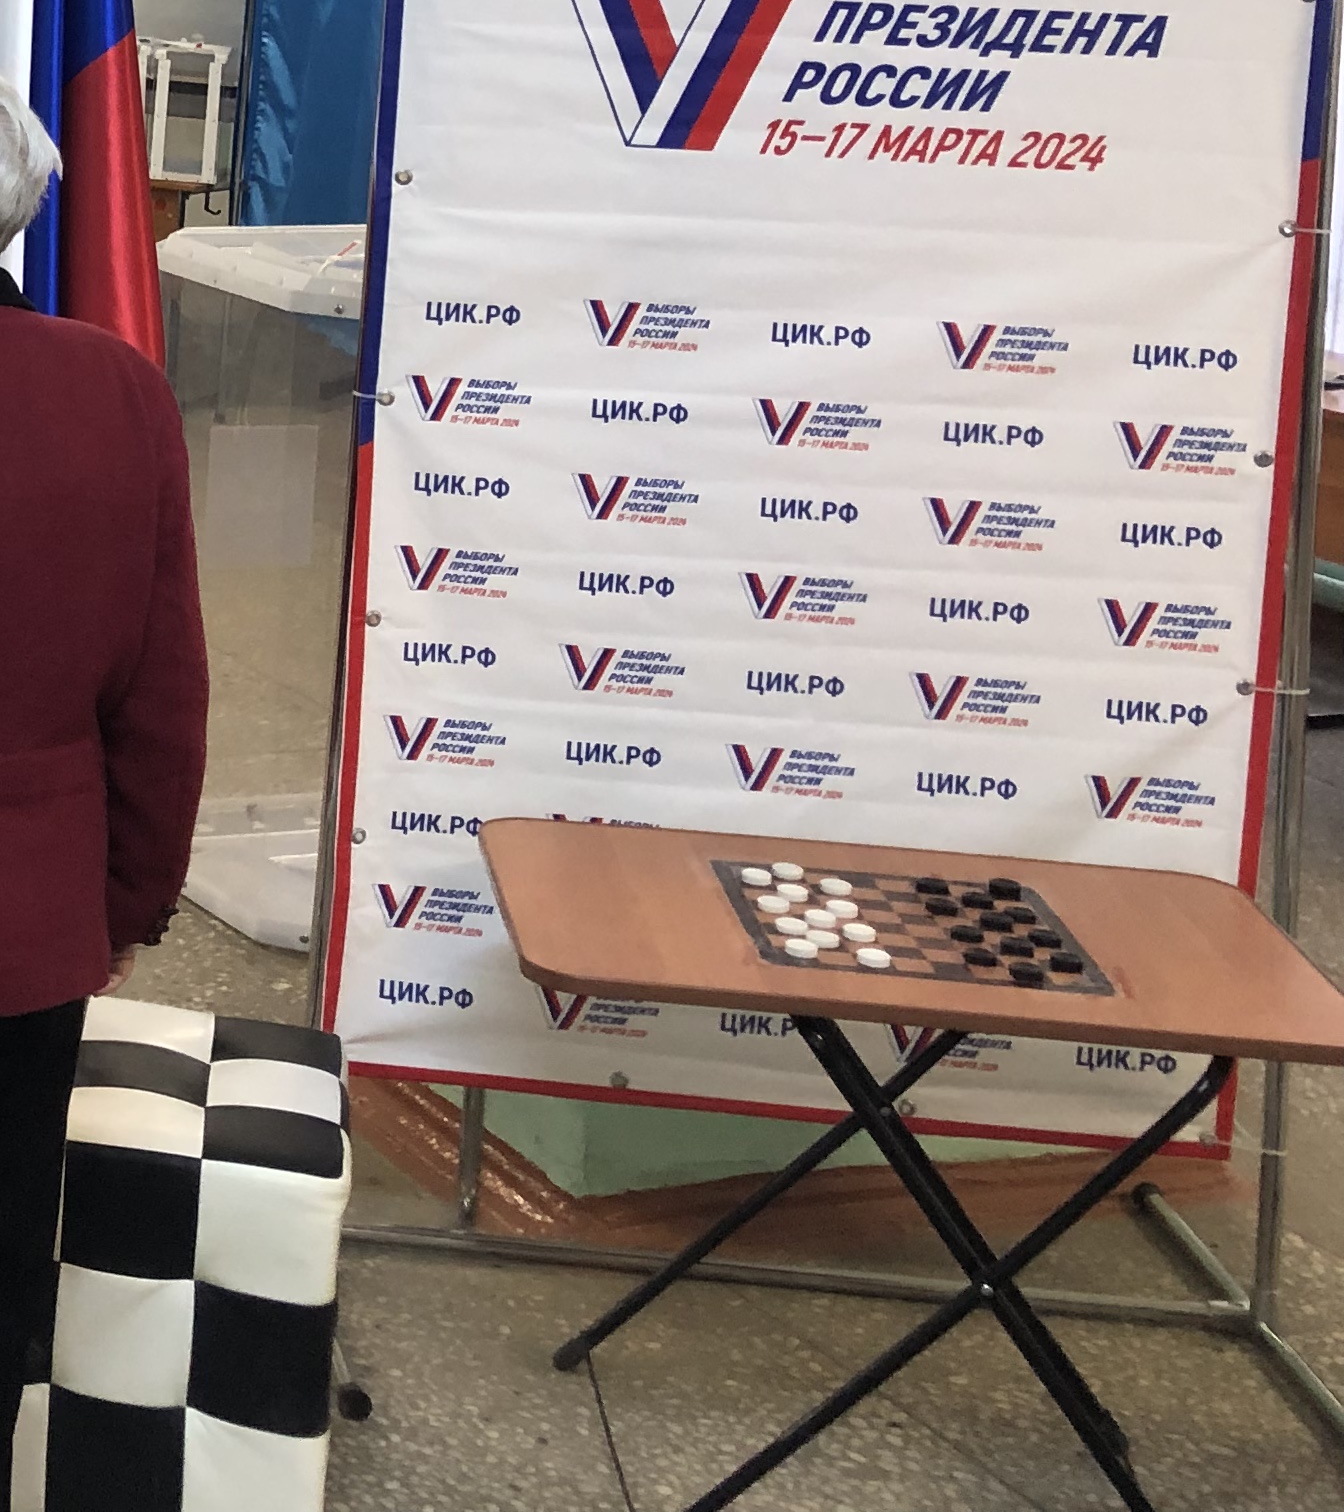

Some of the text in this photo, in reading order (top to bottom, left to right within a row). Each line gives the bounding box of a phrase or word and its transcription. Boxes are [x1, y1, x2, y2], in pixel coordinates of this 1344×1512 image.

[814, 1, 1169, 59] ПРЕЗИДЕНТА
[782, 61, 1010, 112] РОССИИ
[868, 124, 1003, 168] МАРТА
[1007, 131, 1107, 172] 2024
[426, 301, 520, 326] ЦИК.РФ
[646, 304, 696, 315] ВЫБОРЫ
[640, 316, 710, 329] ПРЕЗИДЕНТА
[633, 328, 678, 339] РОССИИ
[772, 322, 871, 348] ЦИК.РФ
[1133, 344, 1237, 371] ЦИК.РФ
[467, 379, 517, 391] ВЫБОРЫ
[462, 392, 531, 404] ПРЕЗИДЕНТА
[455, 403, 500, 414] РОССИИ
[592, 399, 688, 424] ЦИК.РФ
[816, 403, 868, 414] ВЫБОРЫ
[810, 415, 881, 428] ПРЕЗИДЕНТА
[803, 427, 849, 438] РОССИИ
[943, 422, 1043, 447] ЦИК.РФ
[414, 472, 509, 499] ЦИК.РФ
[635, 478, 685, 489] ВЫБОРЫ
[629, 490, 699, 503] ПРЕЗИДЕНТА
[622, 502, 667, 513] РОССИИ
[761, 497, 858, 523] ЦИК.РФ
[988, 503, 1041, 514] ВЫБОРЫ
[982, 515, 1055, 528] ПРЕЗИДЕНТА
[975, 527, 1022, 538] РОССИИ
[1121, 523, 1222, 549] ЦИК.РФ
[455, 550, 505, 562] ВЫБОРЫ
[449, 562, 518, 576] ПРЕЗИДЕНТА
[442, 573, 487, 585] РОССИИ
[579, 571, 674, 597] ЦИК.РФ
[802, 577, 853, 589] ВЫБОРЫ
[796, 590, 867, 603] ПРЕЗИДЕНТА
[789, 601, 835, 612] РОССИИ
[929, 597, 1029, 624] ЦИК.РФ
[404, 642, 496, 668] ЦИК.РФ
[621, 650, 671, 662] ВЫБОРЫ
[615, 662, 685, 675] ПРЕЗИДЕНТА
[608, 673, 654, 685] РОССИИ
[747, 671, 844, 697] ЦИК.РФ
[974, 678, 1027, 690] ВЫБОРЫ
[968, 690, 1041, 704] ПРЕЗИДЕНТА
[961, 702, 1008, 714] РОССИИ
[1106, 699, 1208, 726] ЦИК.РФ
[444, 720, 492, 731] ВЫБОРЫ
[438, 732, 506, 745] ПРЕЗИДЕНТА
[431, 743, 475, 754] РОССИИ
[566, 741, 661, 767] ЦИК.РФ
[790, 750, 841, 762] ВЫБОРЫ
[783, 762, 855, 776] ПРЕЗИДЕНТА
[776, 774, 823, 786] РОССИИ
[917, 772, 1017, 800] ЦИК.РФ
[391, 811, 484, 837] ЦИК.РФ
[431, 888, 480, 900] ВЫБОРЫ
[425, 900, 493, 914] ПРЕЗИДЕНТА
[419, 911, 463, 923] РОССИИ
[379, 979, 474, 1009] ЦИК.РФ
[1076, 1046, 1178, 1075] ЦИК.РФ
